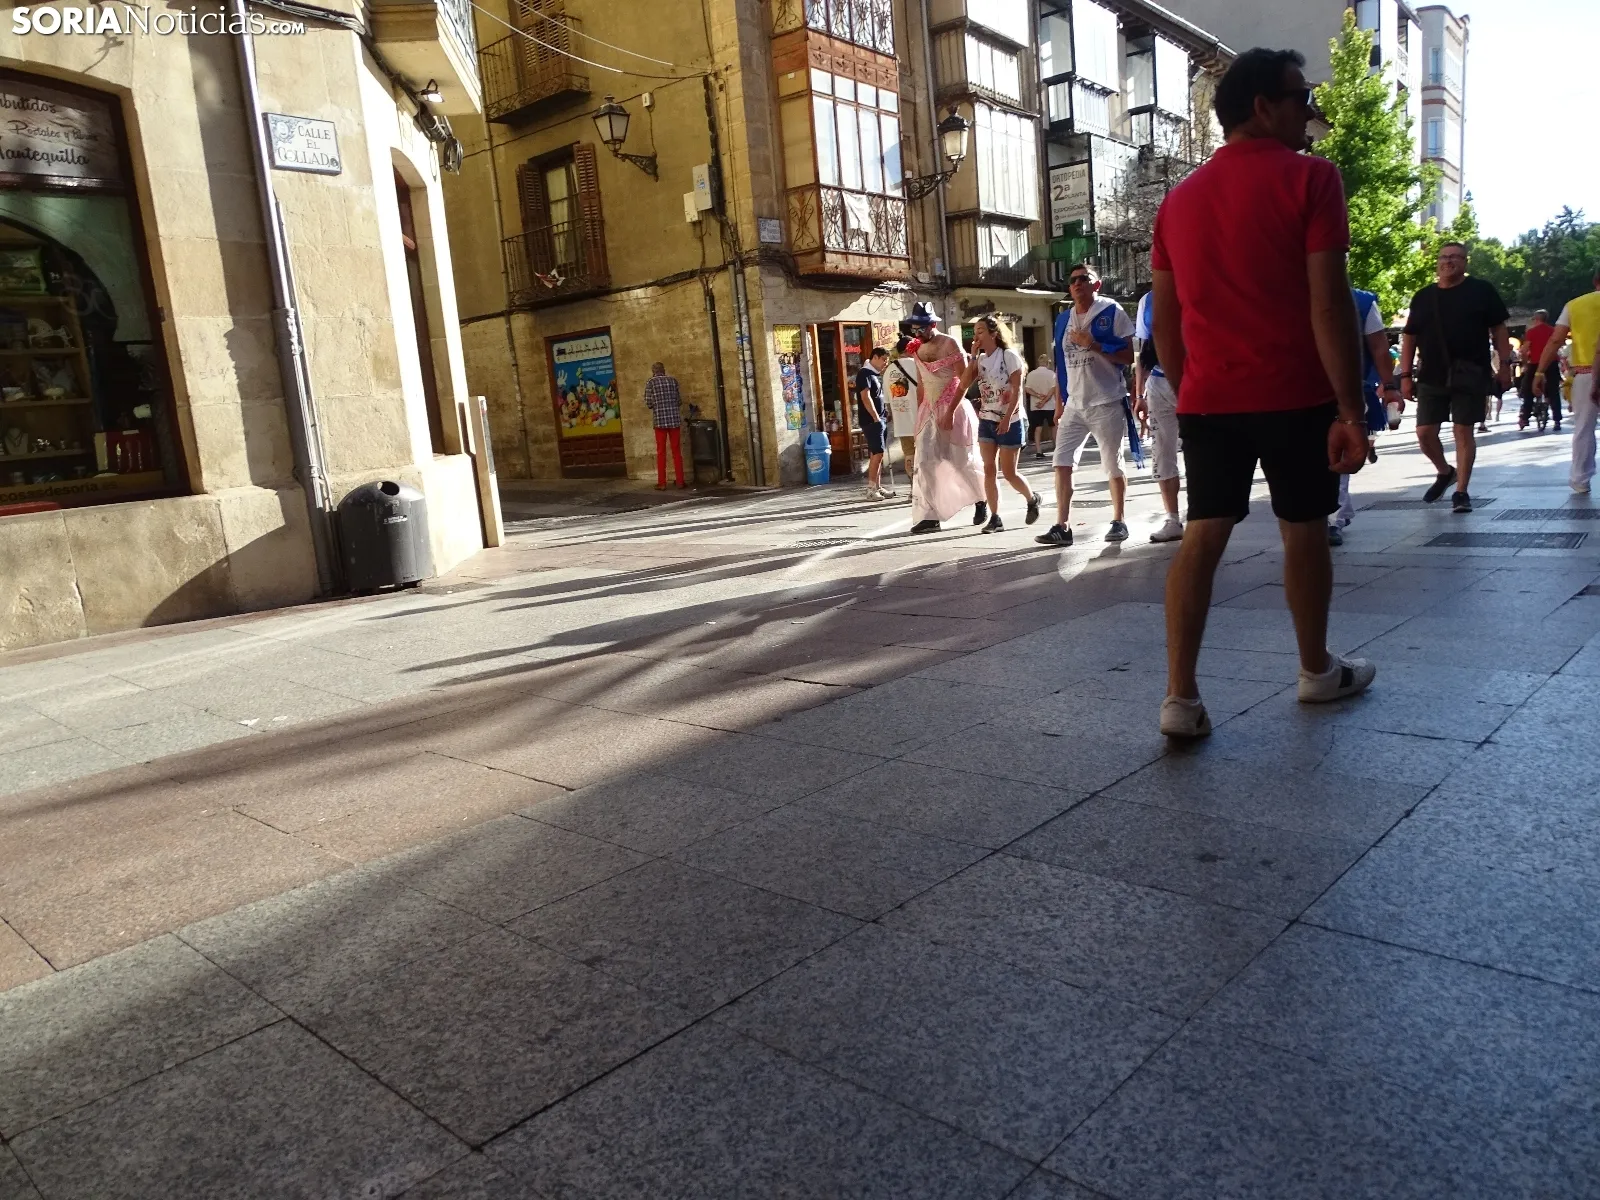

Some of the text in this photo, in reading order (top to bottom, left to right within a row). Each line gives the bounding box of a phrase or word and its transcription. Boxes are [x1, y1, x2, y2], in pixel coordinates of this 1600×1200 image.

[0, 93, 57, 113] butidos
[298, 125, 331, 140] CALLE
[306, 138, 321, 150] EL
[278, 147, 340, 169] COLLADO
[1052, 169, 1086, 183] ORTOPEDIA
